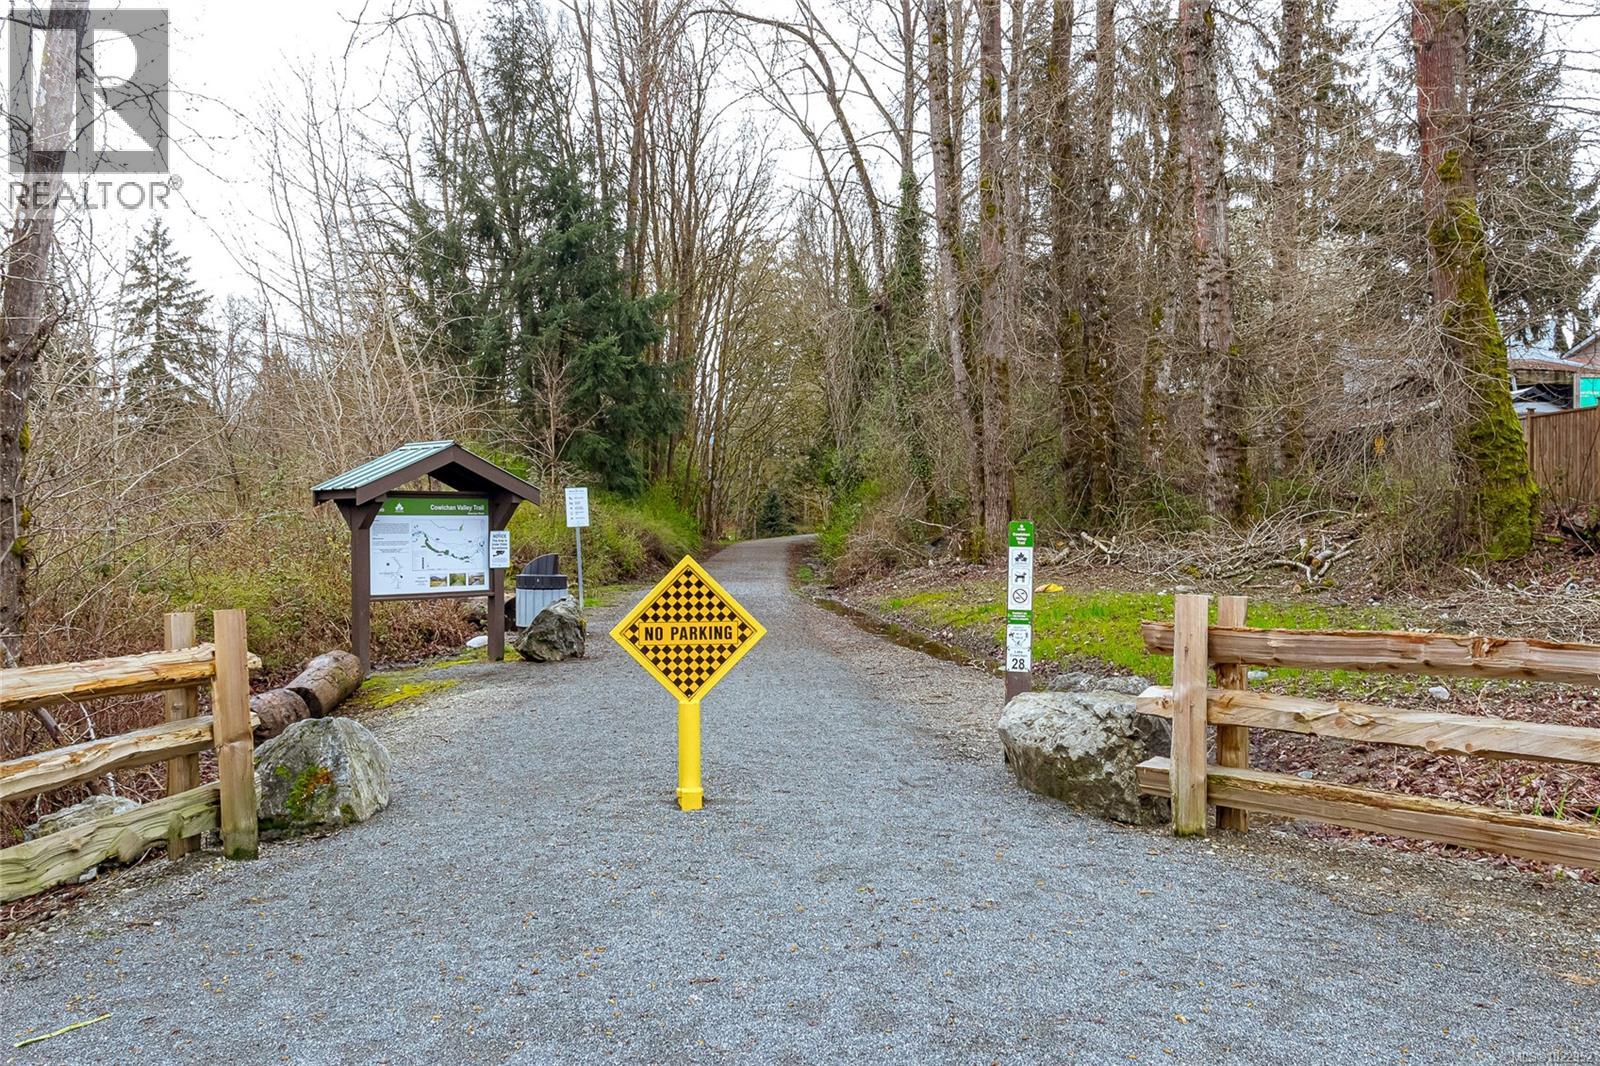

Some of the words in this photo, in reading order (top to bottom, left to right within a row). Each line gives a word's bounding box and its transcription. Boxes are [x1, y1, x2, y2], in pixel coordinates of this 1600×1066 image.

[456, 504, 472, 512] Valley
[644, 626, 663, 641] NO
[670, 625, 732, 641] PARKING
[1011, 658, 1025, 670] 28
